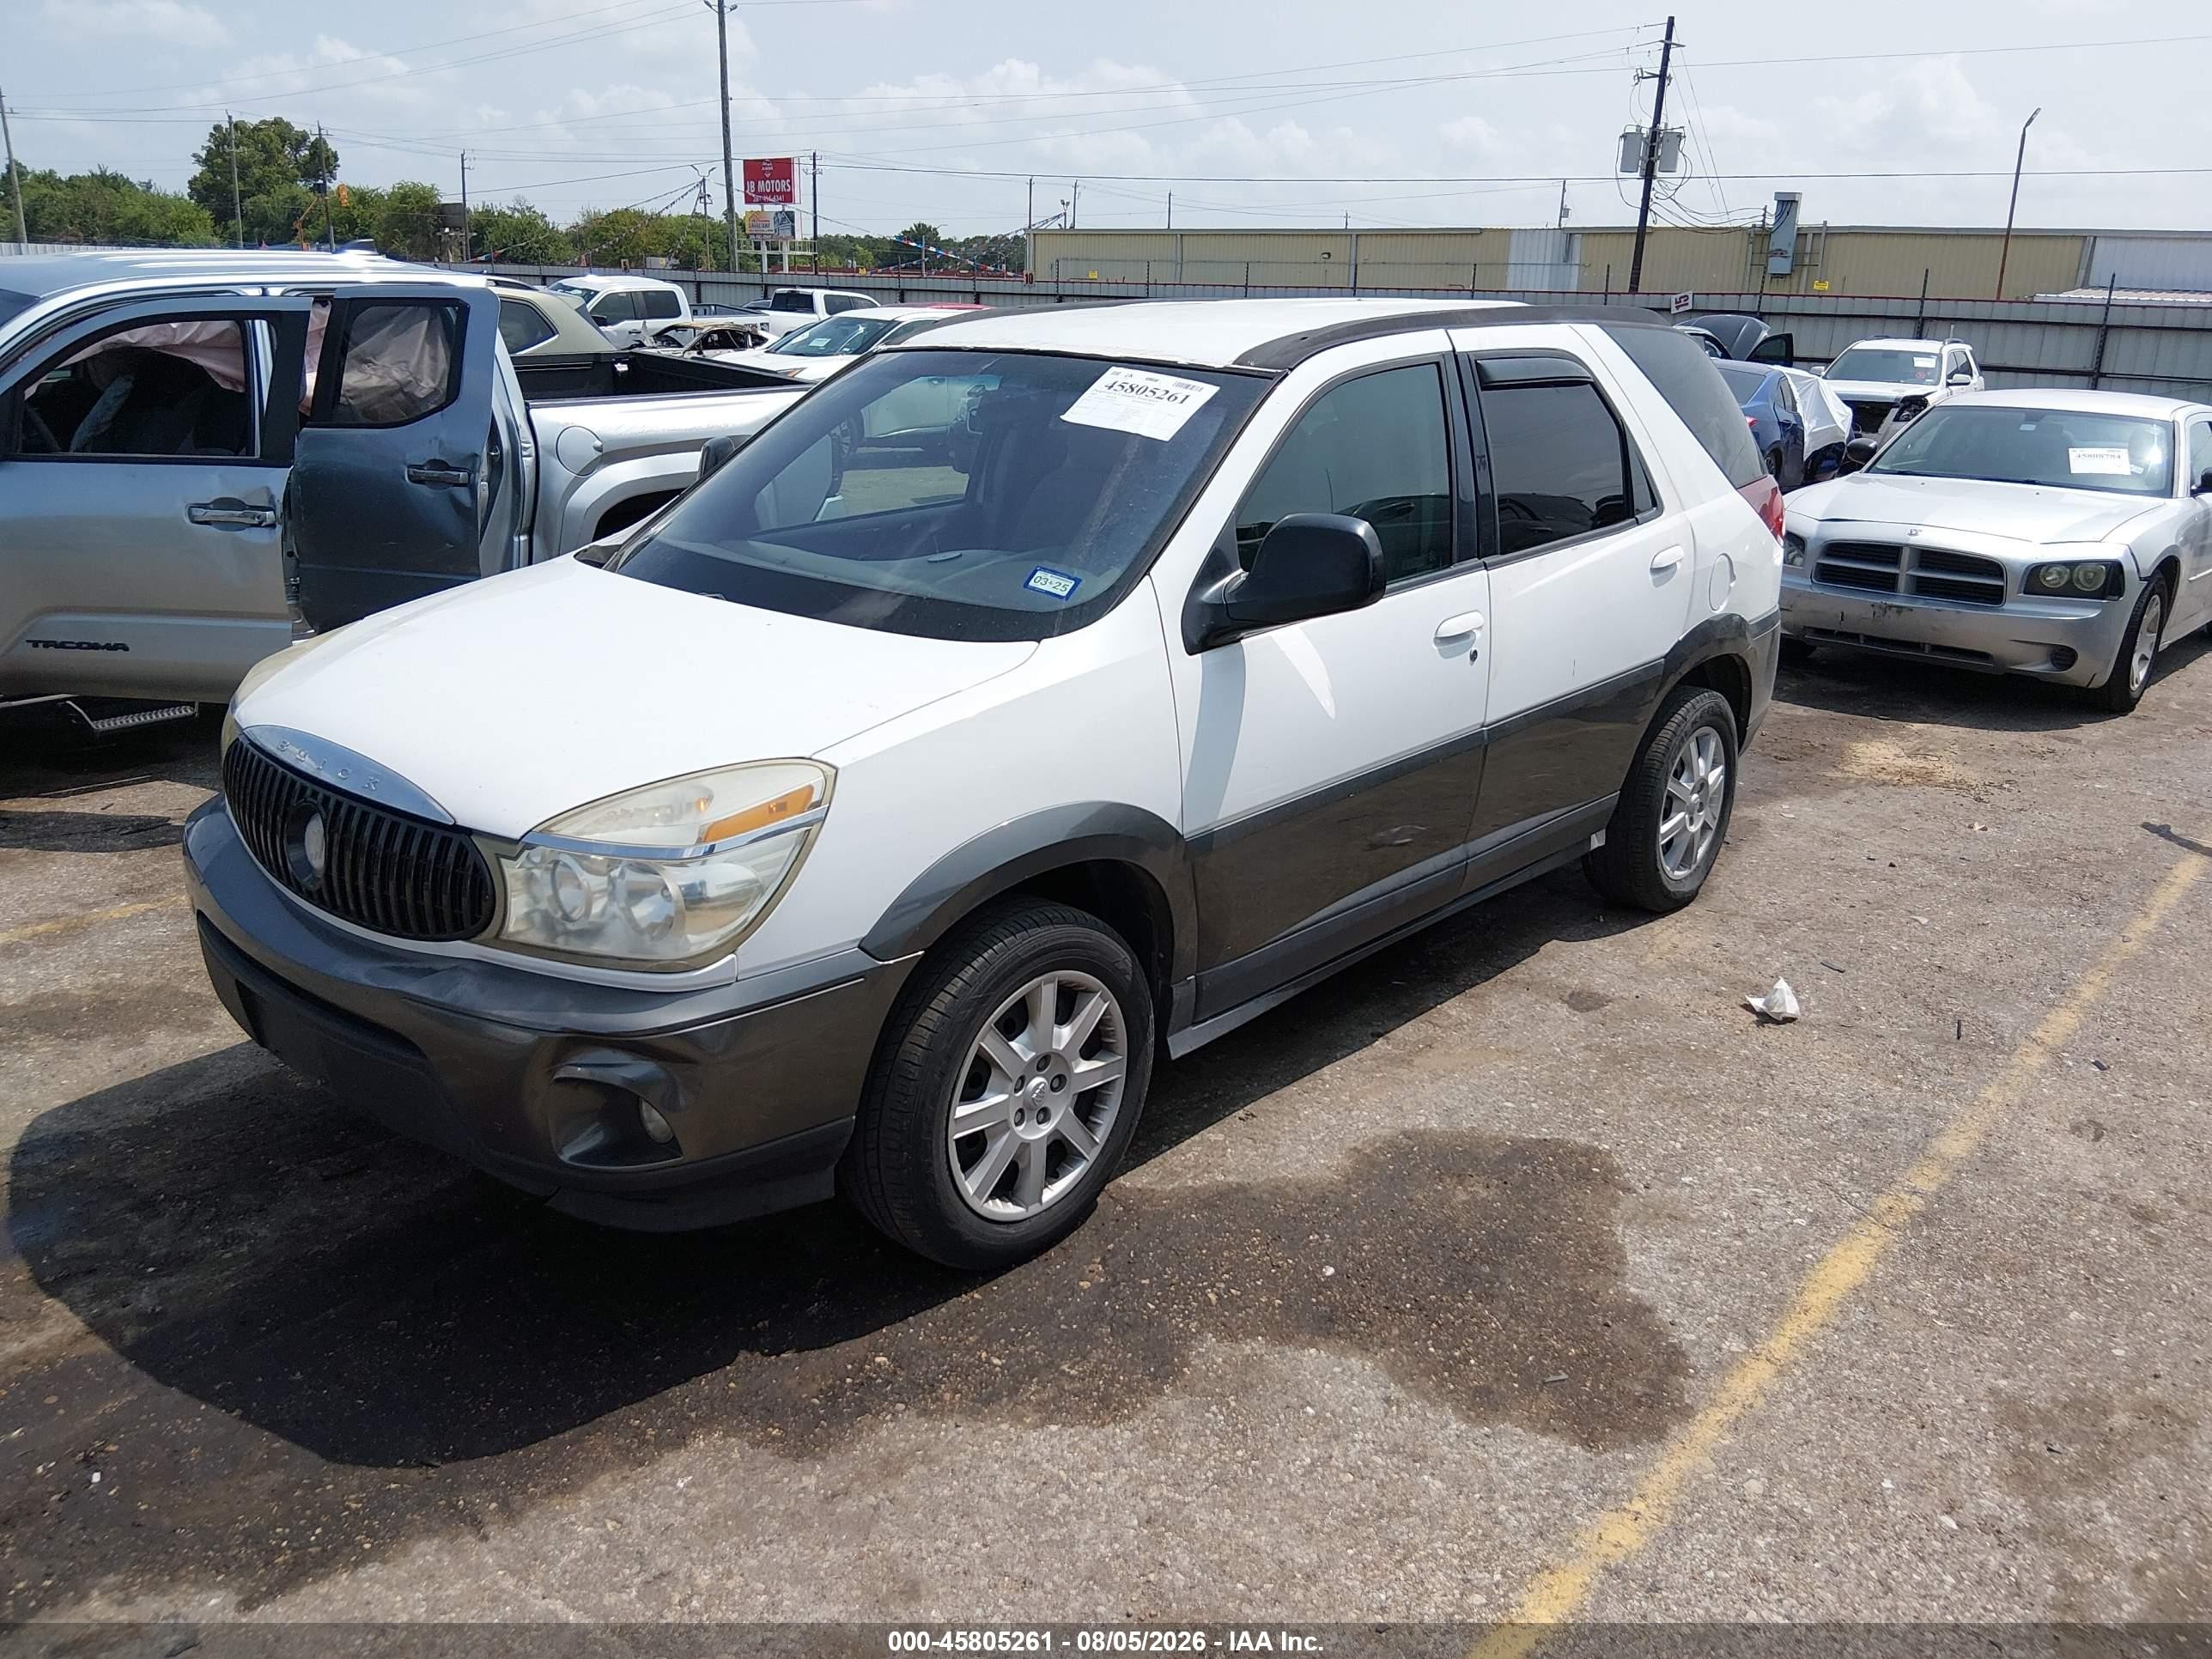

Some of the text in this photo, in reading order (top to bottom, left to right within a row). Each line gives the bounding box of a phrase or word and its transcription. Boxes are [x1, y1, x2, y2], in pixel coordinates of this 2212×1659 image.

[746, 179, 791, 193] JB MOTORS
[1025, 273, 1034, 284] 10
[1675, 295, 1689, 310] 15
[1104, 380, 1191, 404] 45805261
[26, 640, 130, 652] TACOMA
[277, 739, 380, 791] BUICK
